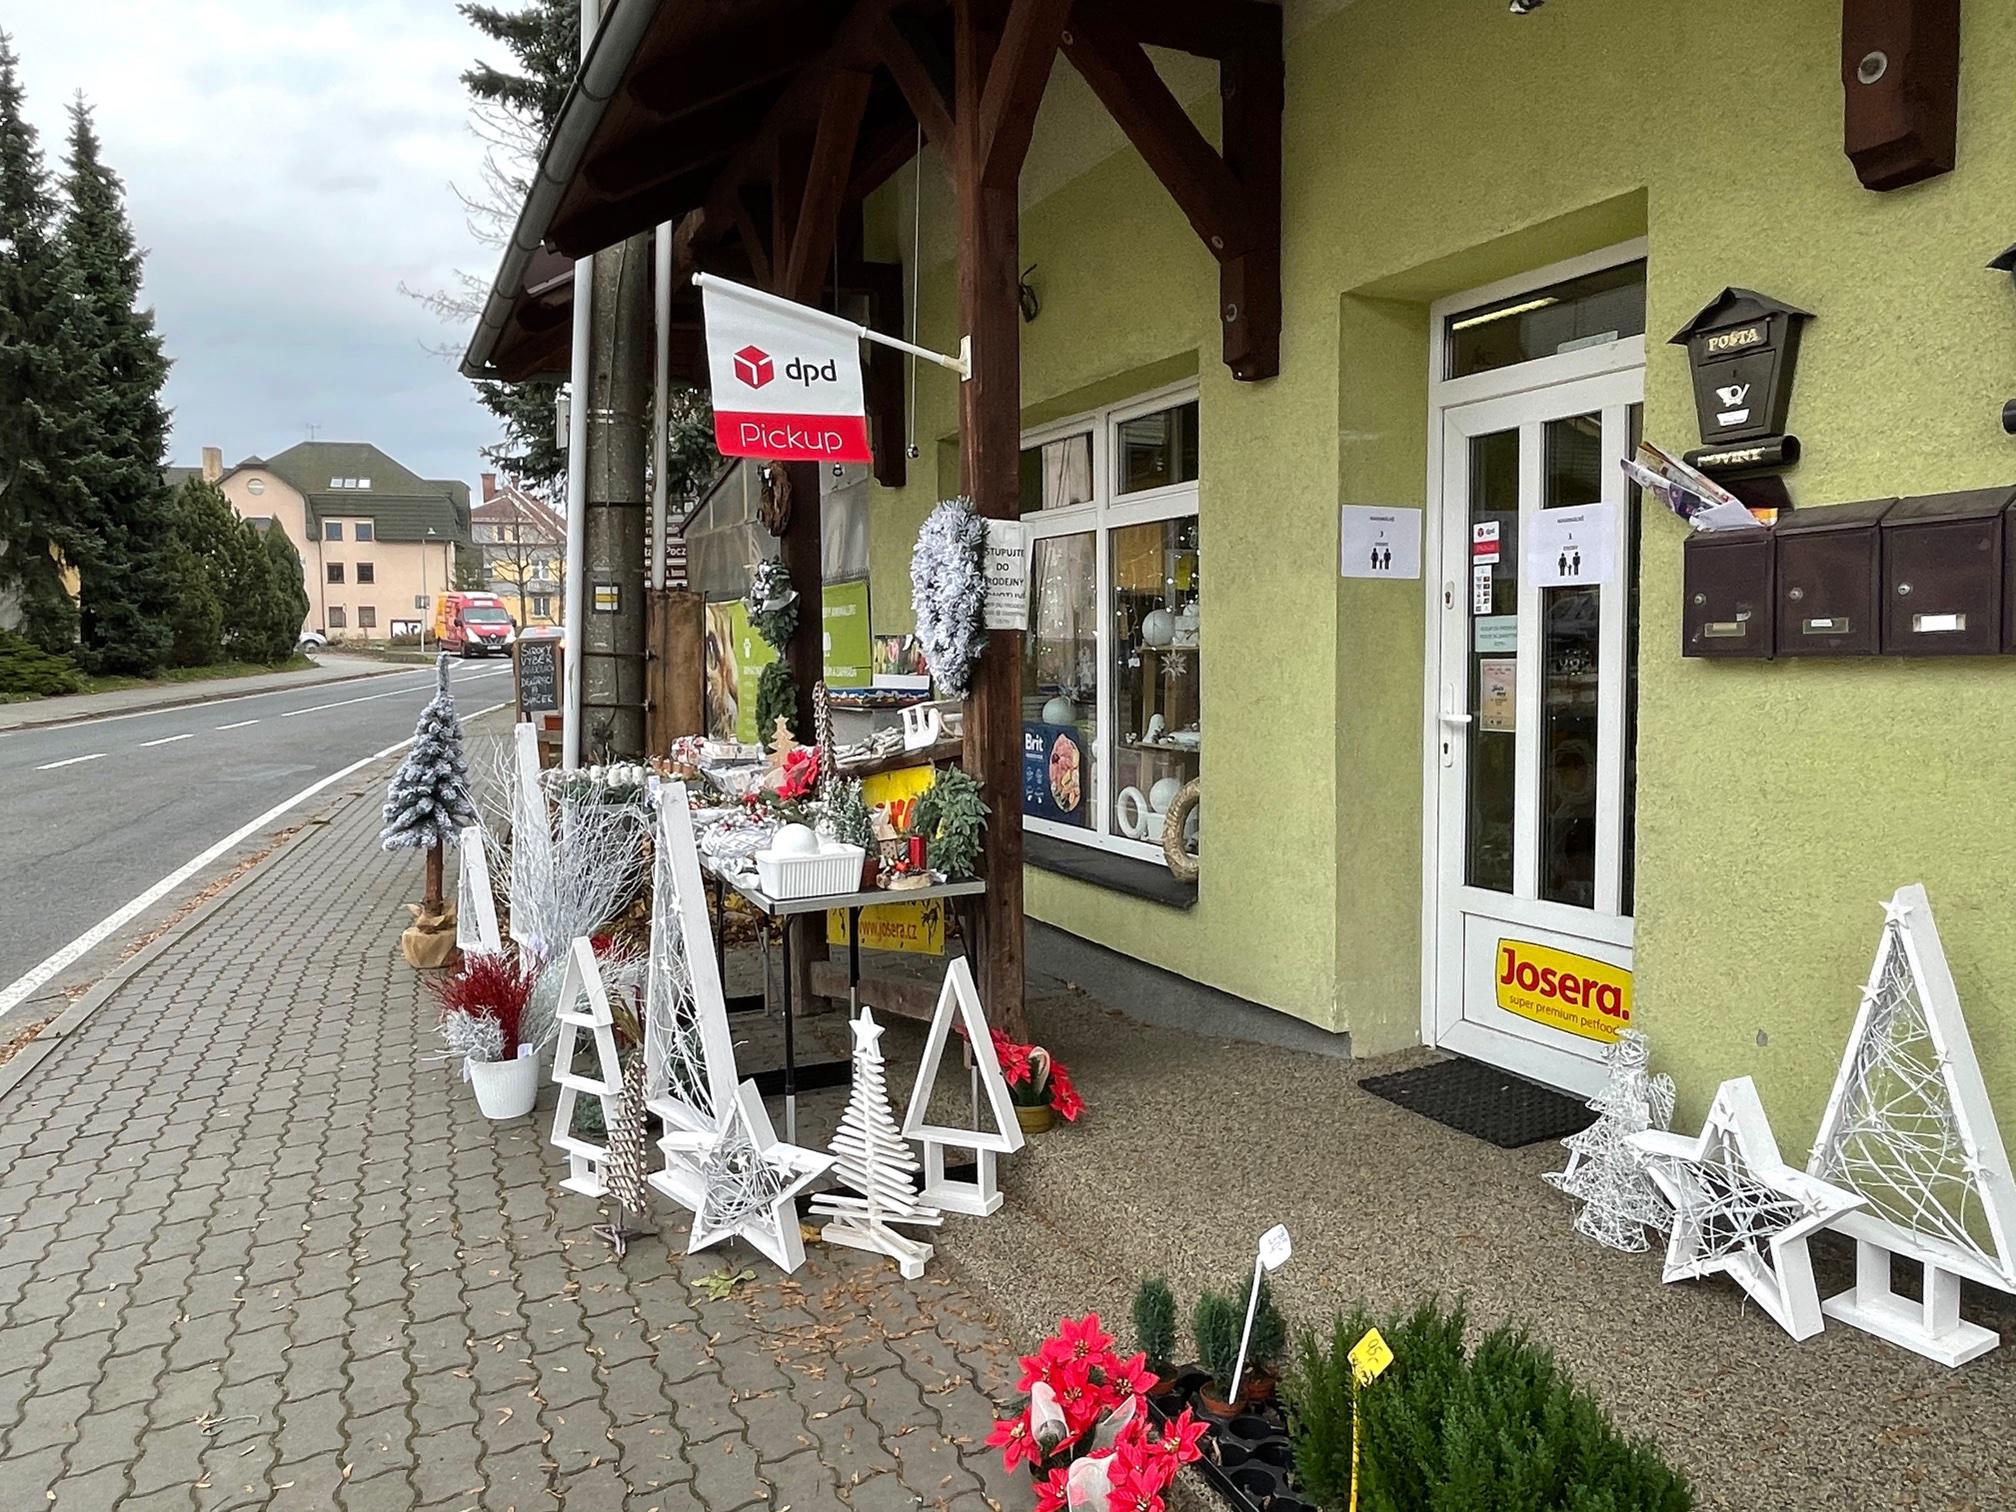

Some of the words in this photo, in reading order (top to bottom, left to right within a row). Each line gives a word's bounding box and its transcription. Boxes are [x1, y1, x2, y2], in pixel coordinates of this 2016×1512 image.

[785, 356, 838, 388] dpd
[740, 423, 843, 454] Pickup
[984, 547, 1025, 558] STUPUJTE
[996, 562, 1010, 571] DO
[984, 577, 1024, 587] RODEJNY
[1024, 732, 1044, 752] Brit
[1509, 995, 1534, 1009] super
[1535, 1003, 1578, 1024] premium
